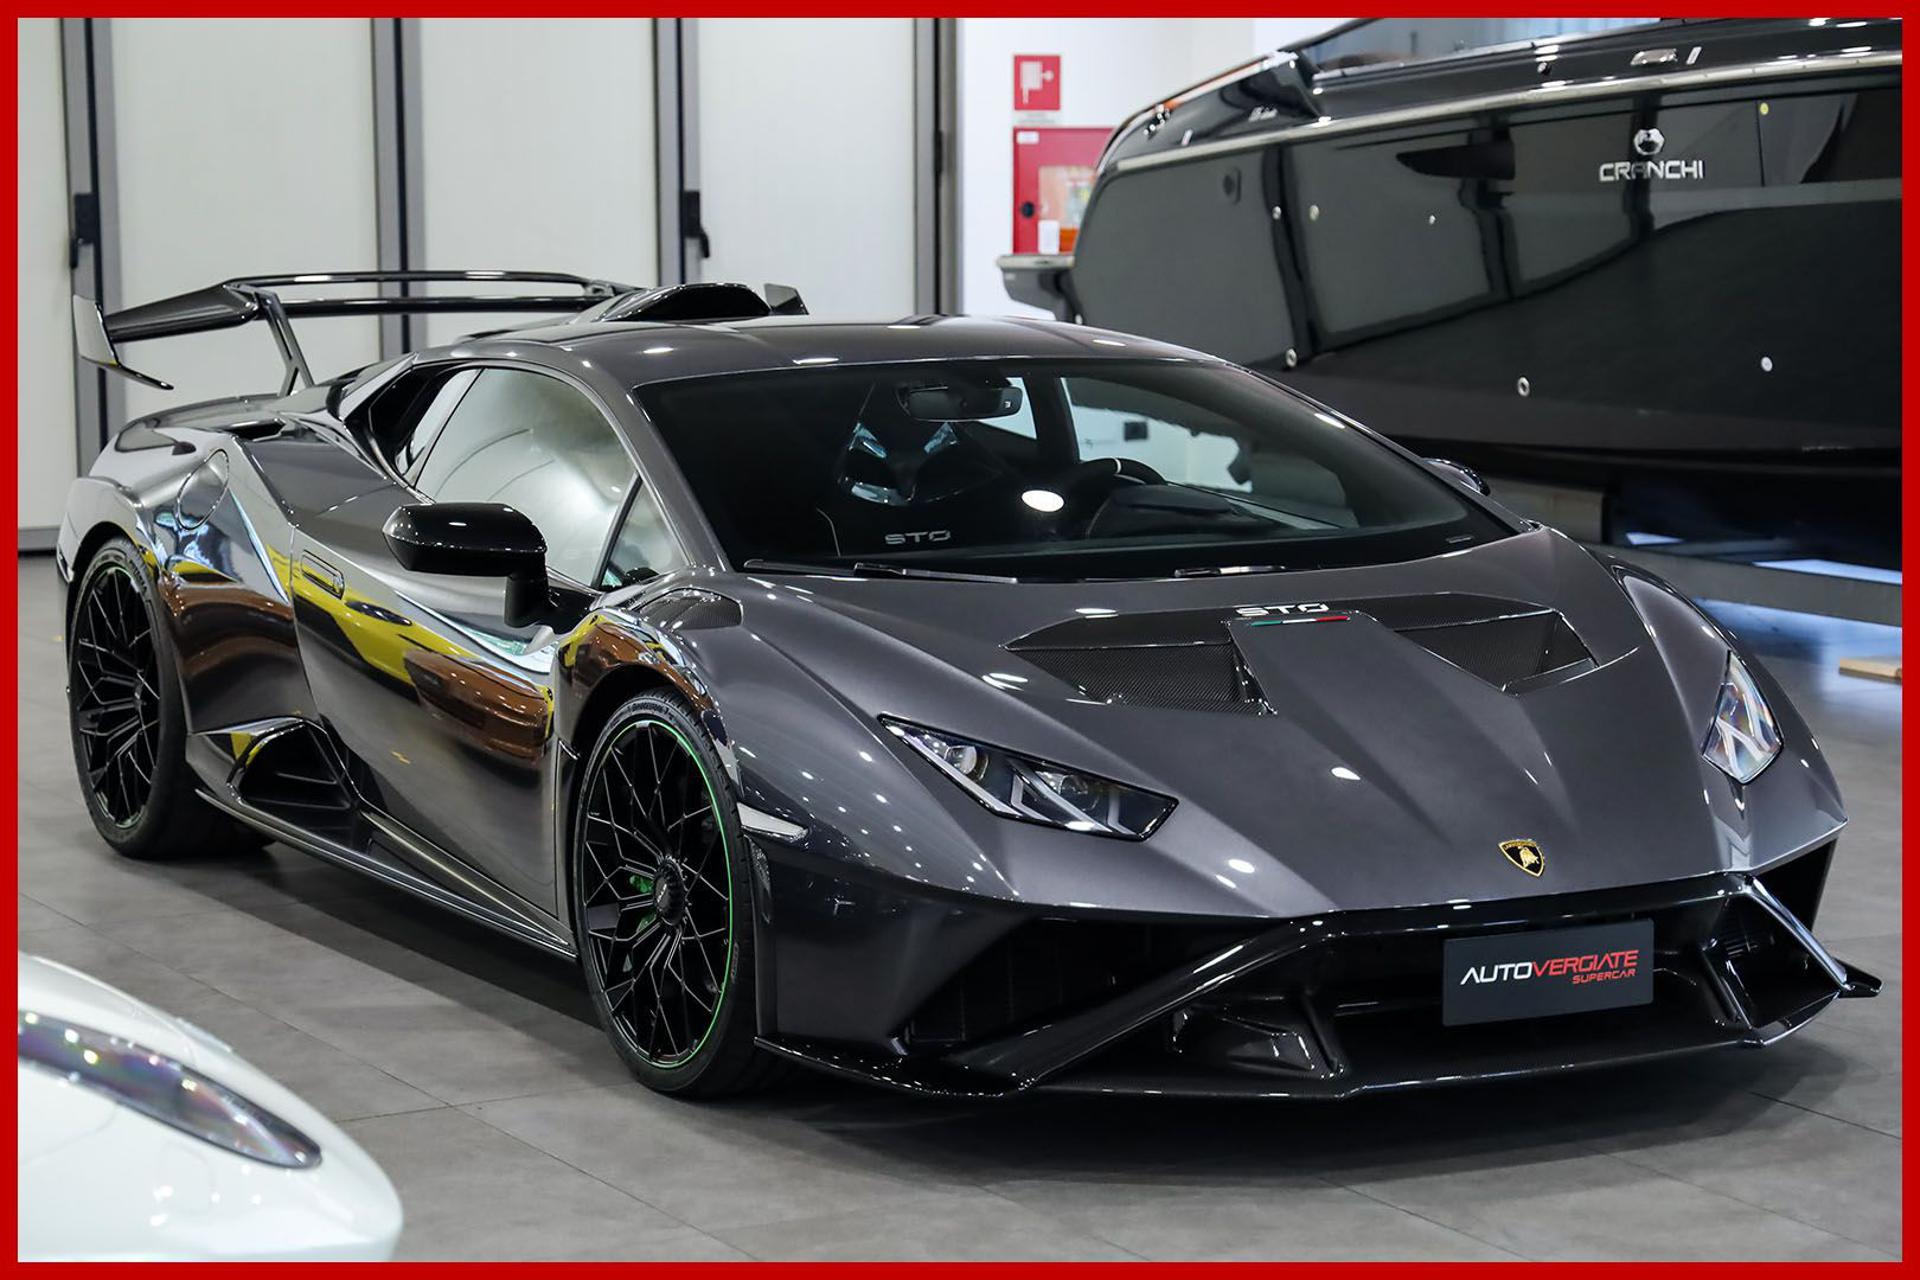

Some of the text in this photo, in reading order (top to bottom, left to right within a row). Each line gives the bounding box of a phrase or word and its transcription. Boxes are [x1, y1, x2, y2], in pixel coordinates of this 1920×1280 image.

[1599, 160, 1704, 181] CRANCHI
[885, 530, 951, 544] STO
[1236, 603, 1329, 617] STO
[1460, 950, 1640, 985] AUTOVERGIATE
[1572, 969, 1637, 984] SUPERCAR
